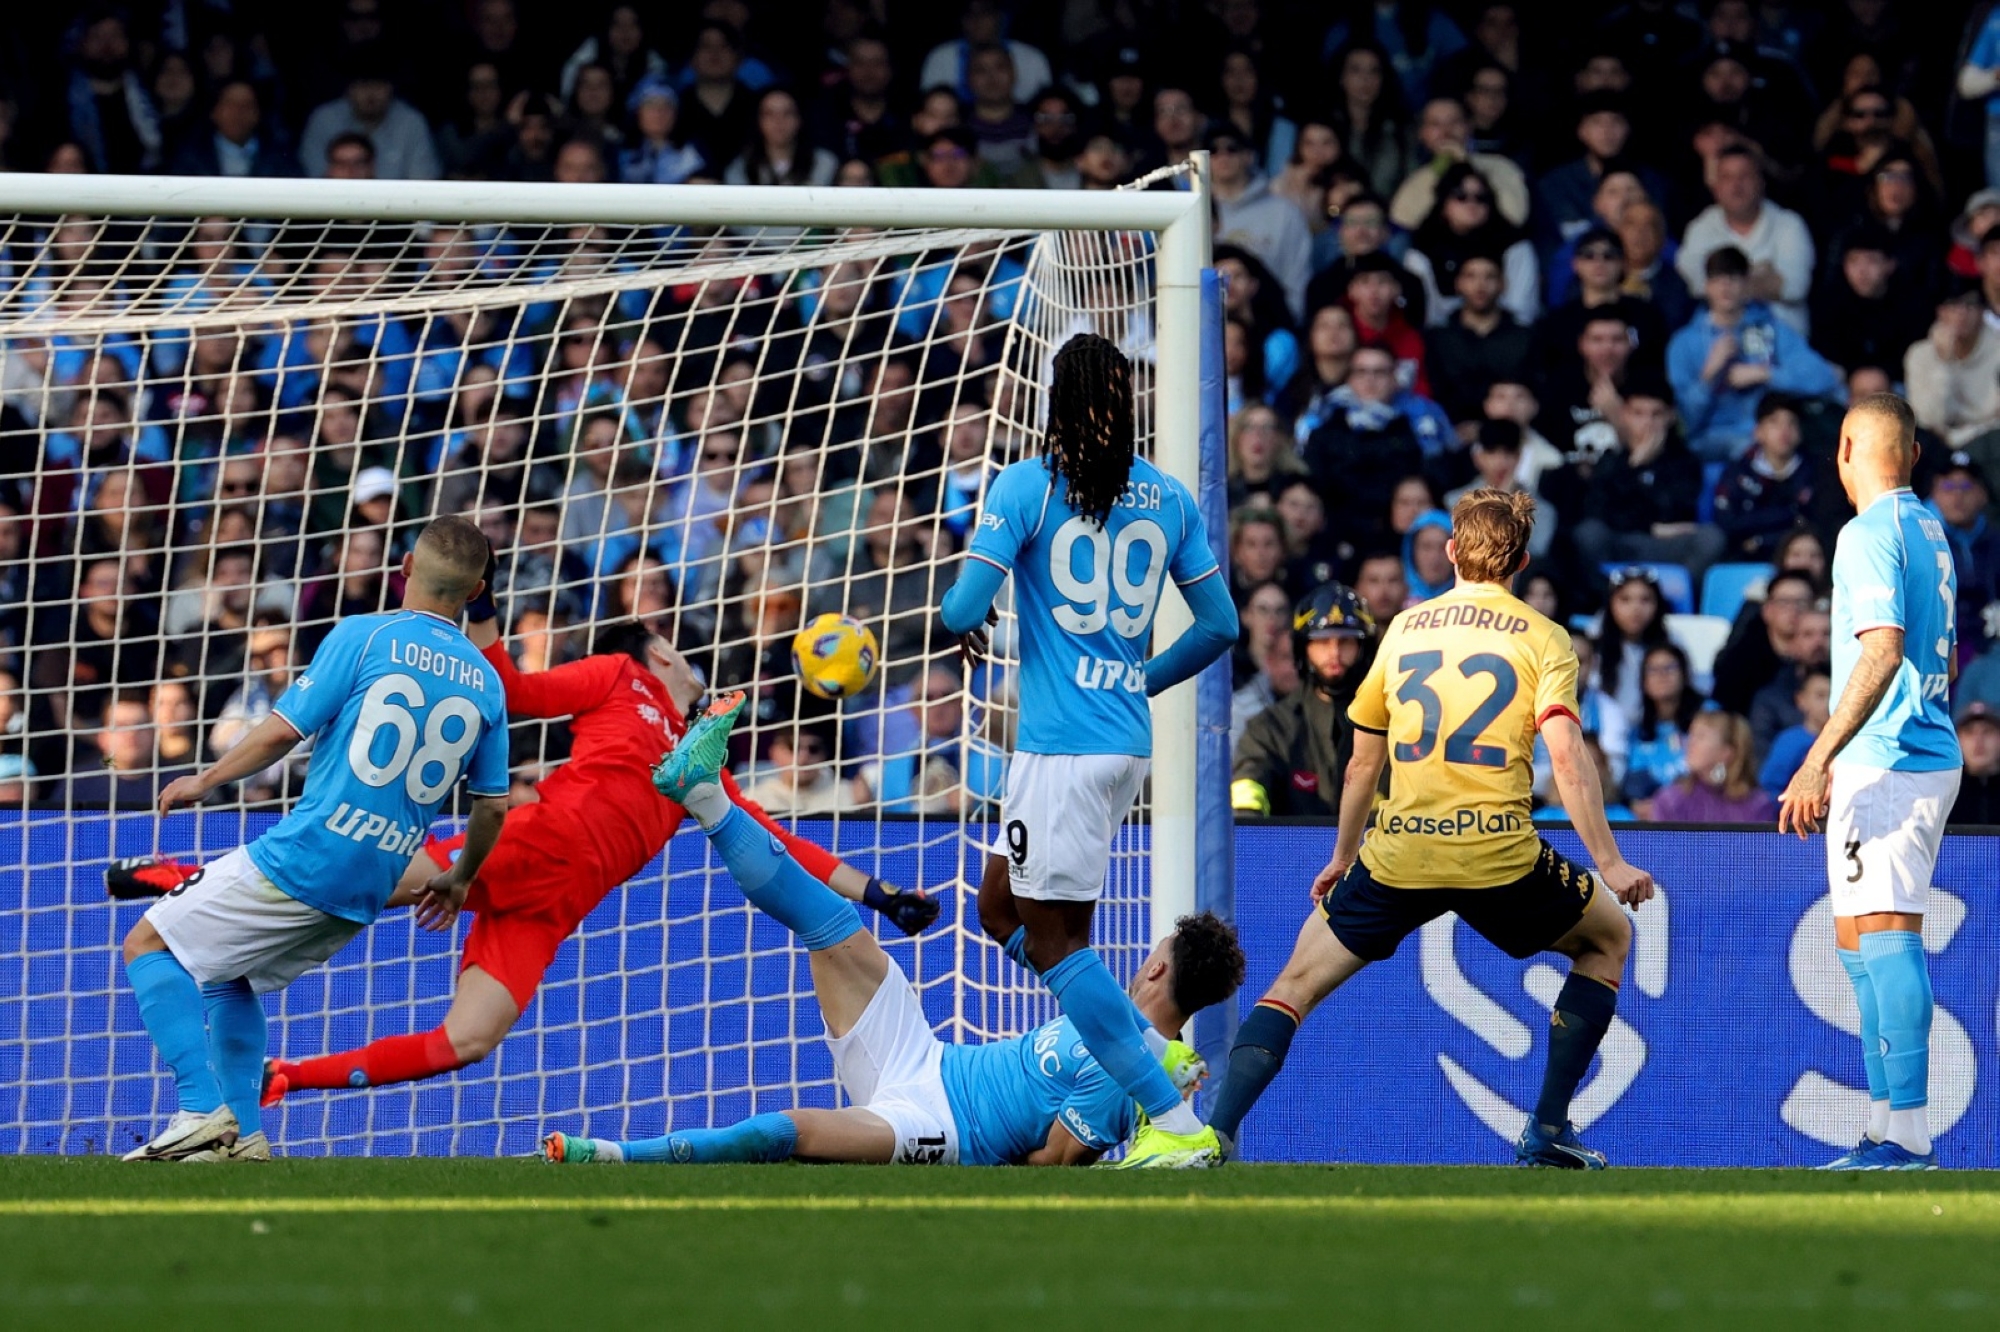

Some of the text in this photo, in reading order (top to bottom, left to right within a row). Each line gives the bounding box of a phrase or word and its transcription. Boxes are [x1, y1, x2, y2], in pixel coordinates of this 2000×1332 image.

[1050, 515, 1169, 638] 99
[1935, 549, 1957, 659] 3
[1403, 604, 1530, 635] FRENDRUP
[390, 638, 486, 693] LOBOTKA
[1394, 649, 1519, 769] 32
[348, 672, 483, 805] 68
[324, 802, 425, 857] UPbit
[1006, 819, 1028, 866] 9
[1380, 808, 1521, 837] LeasePlan
[1845, 840, 1864, 883] 3
[1034, 1016, 1064, 1078] MSC
[1065, 1106, 1100, 1142] ebay
